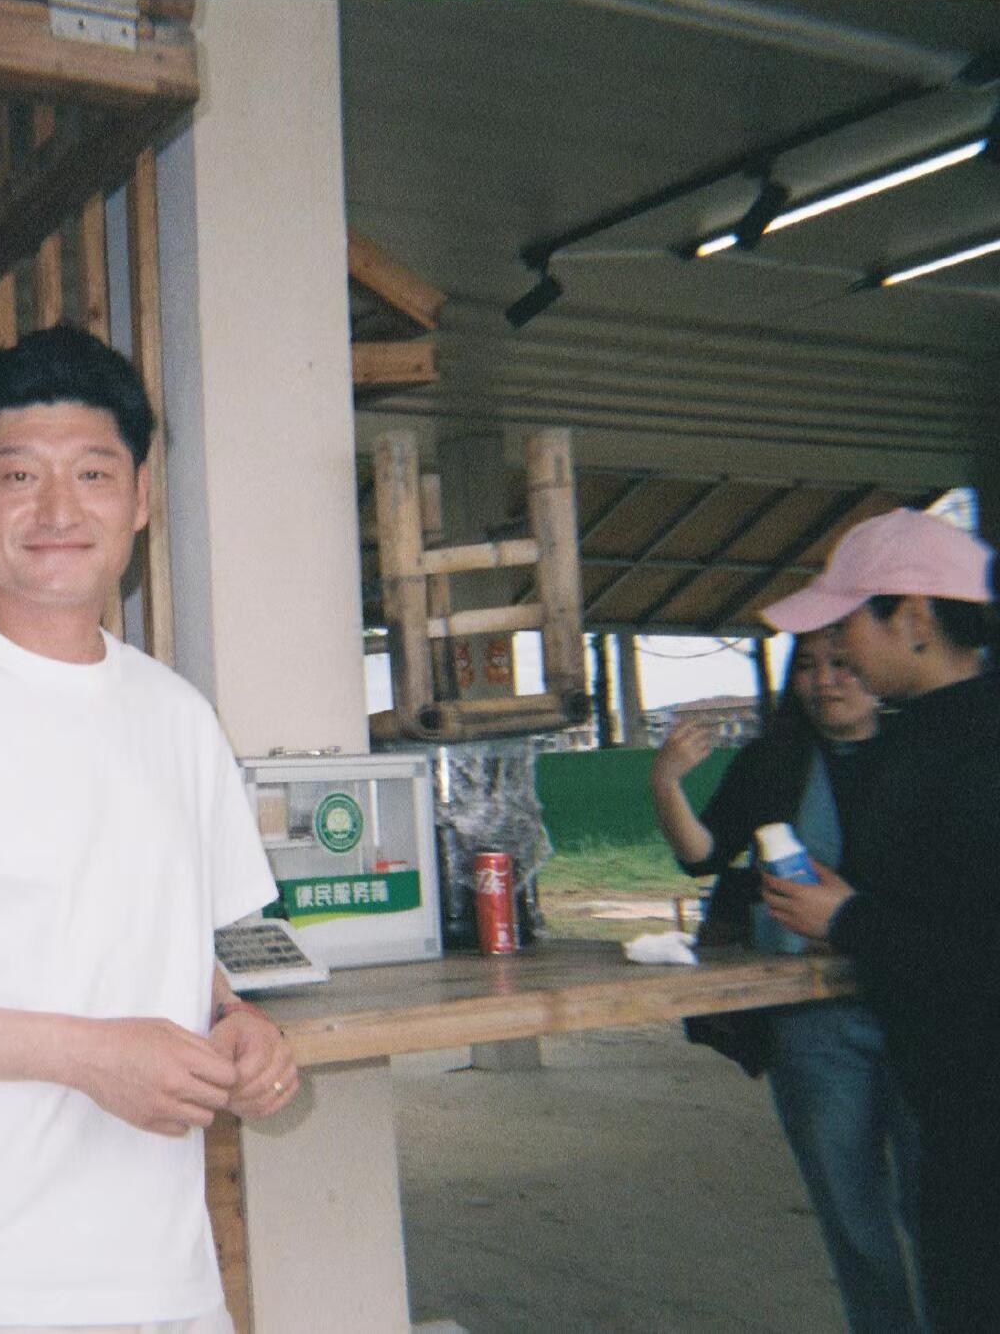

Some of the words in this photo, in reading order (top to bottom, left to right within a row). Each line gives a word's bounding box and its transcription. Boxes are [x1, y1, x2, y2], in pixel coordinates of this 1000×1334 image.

[295, 880, 389, 908] 便民服务箱
